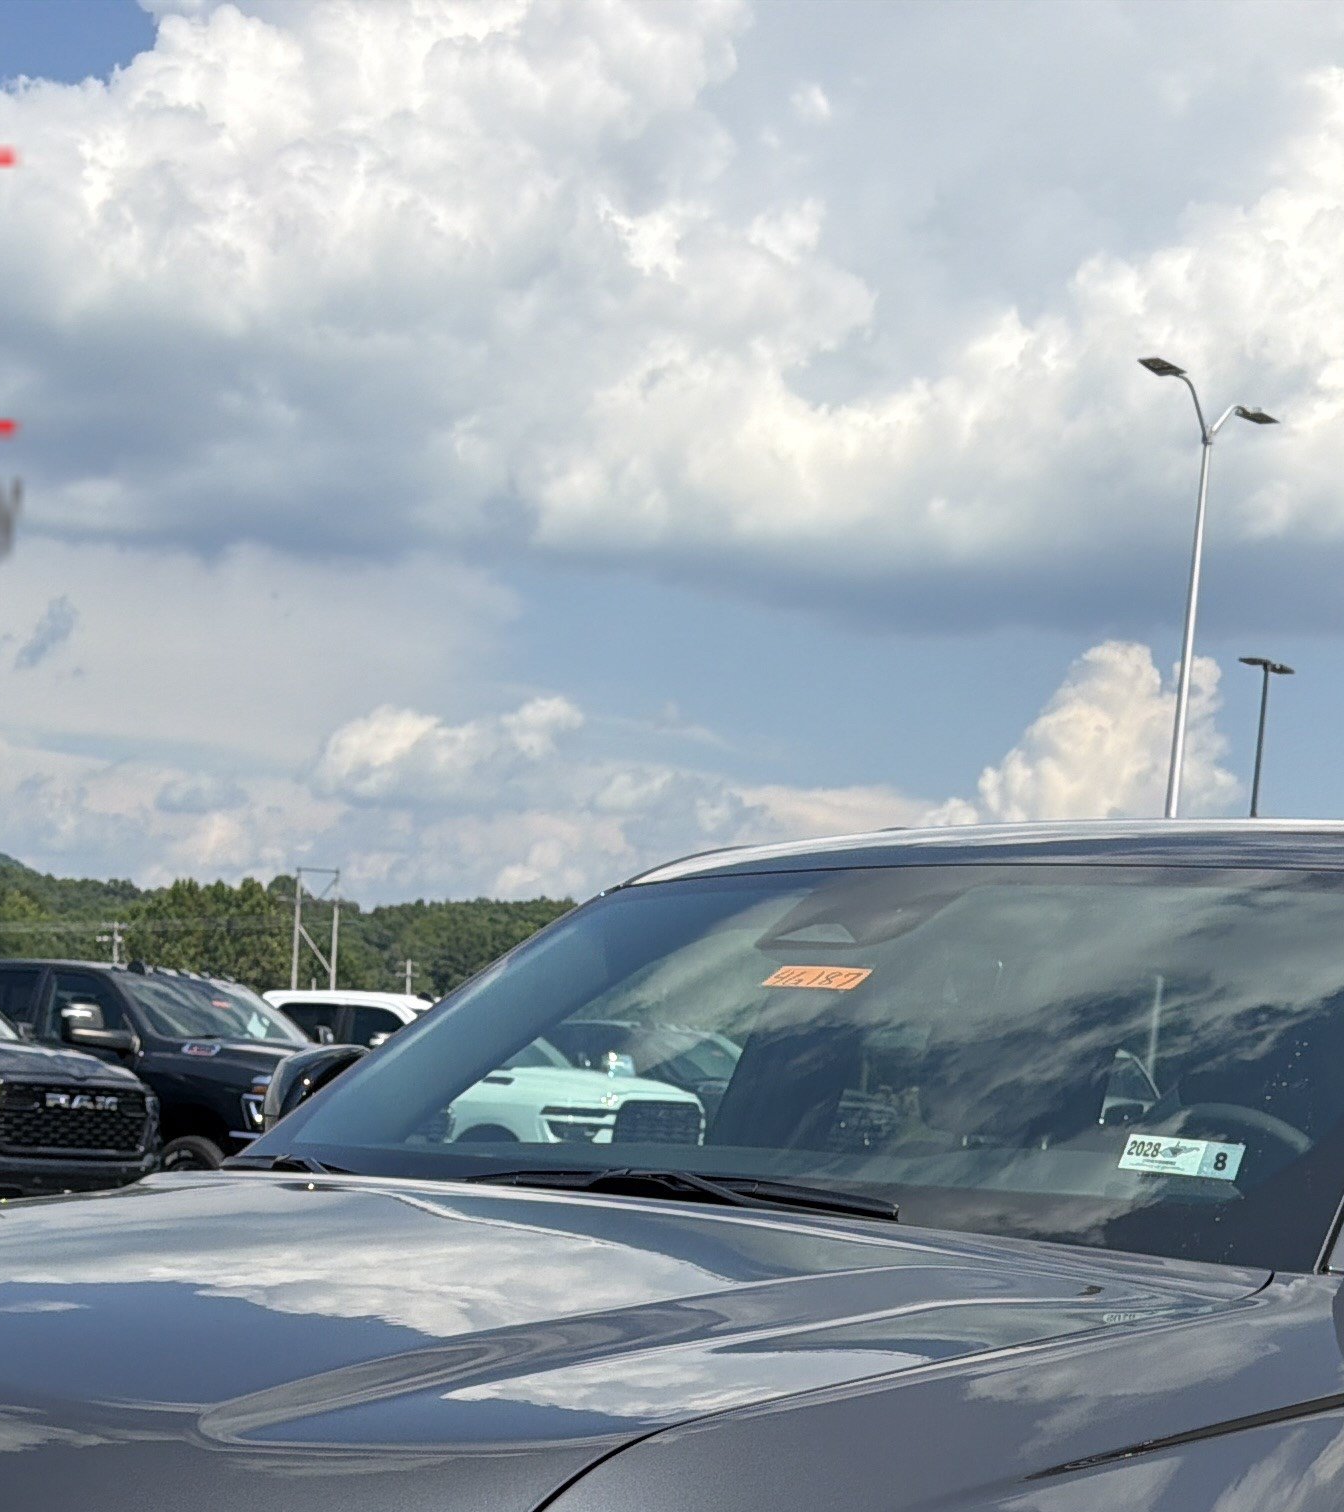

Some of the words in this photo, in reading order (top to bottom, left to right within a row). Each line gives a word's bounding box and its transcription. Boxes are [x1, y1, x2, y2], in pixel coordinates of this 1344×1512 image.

[45, 1092, 119, 1111] RAM
[1126, 1140, 1162, 1157] 2028
[1213, 1152, 1228, 1171] 8
